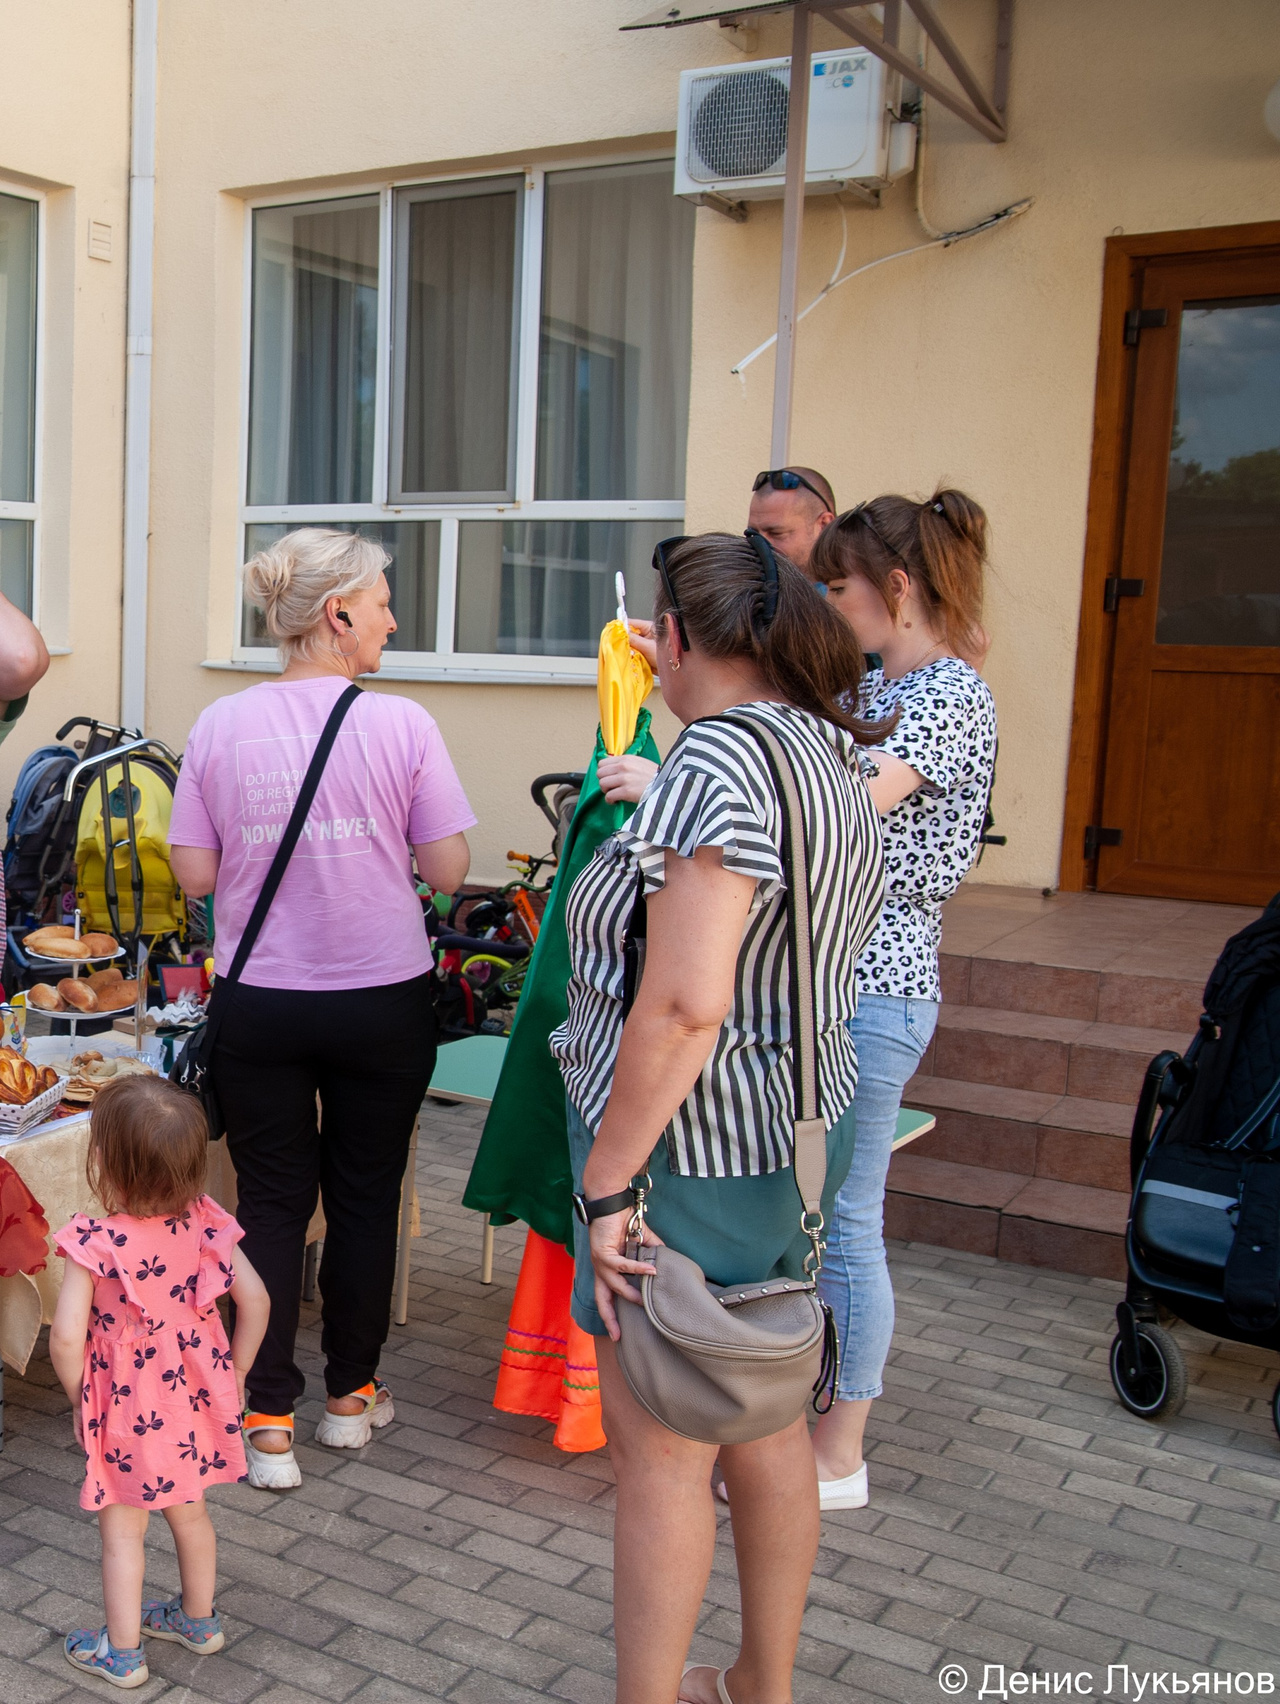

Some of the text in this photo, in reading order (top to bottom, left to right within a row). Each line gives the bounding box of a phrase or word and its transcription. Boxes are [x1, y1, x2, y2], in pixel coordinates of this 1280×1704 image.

[828, 57, 868, 75] JAX
[245, 773, 265, 786] DO
[267, 771, 279, 784] IT
[247, 789, 264, 801] OR
[249, 804, 260, 816] IT
[241, 823, 283, 845] NOW
[320, 817, 377, 840] NEVER
